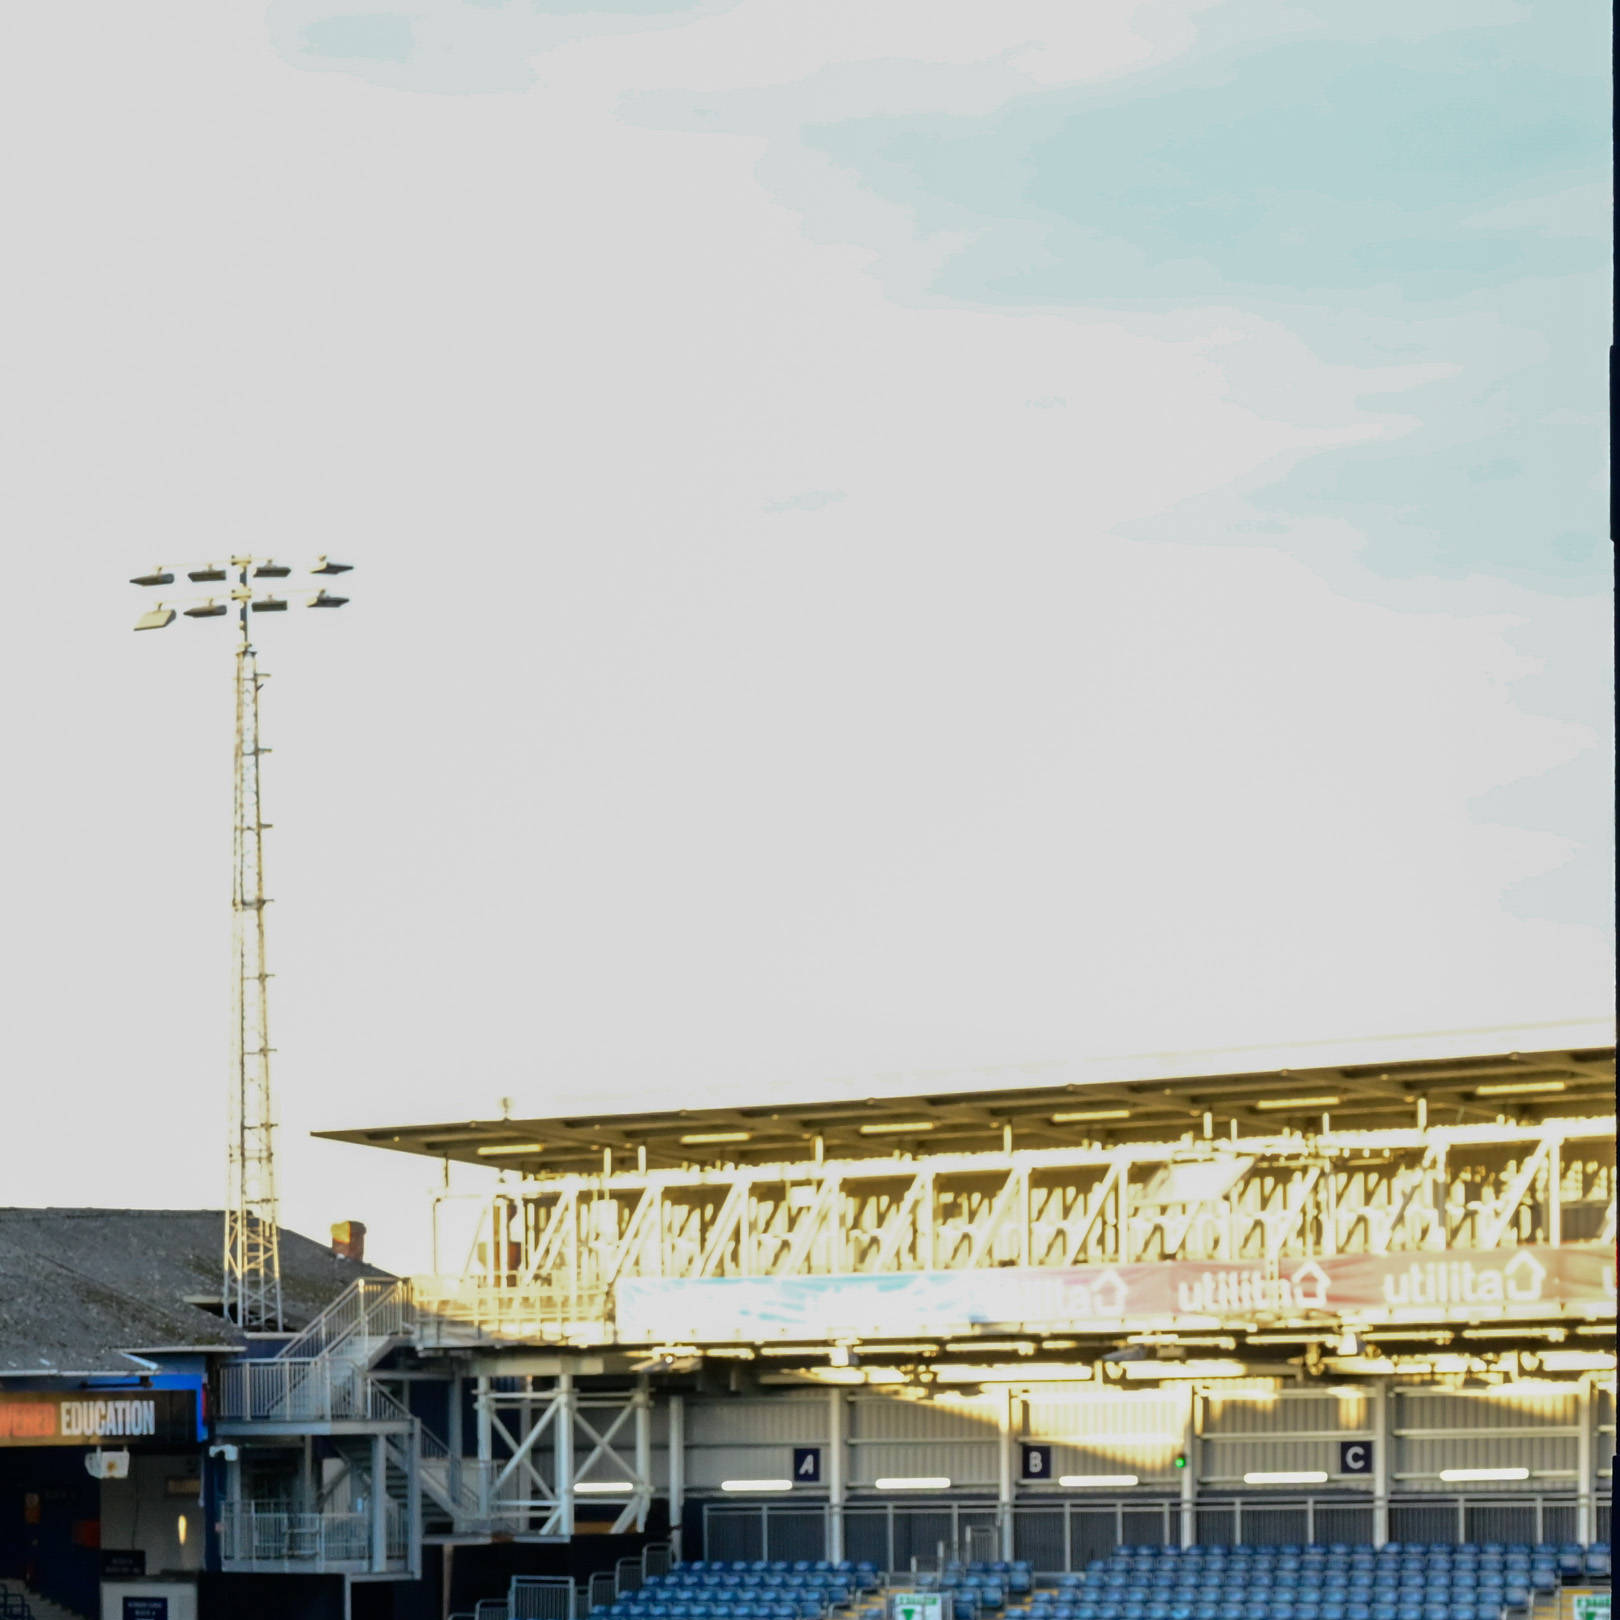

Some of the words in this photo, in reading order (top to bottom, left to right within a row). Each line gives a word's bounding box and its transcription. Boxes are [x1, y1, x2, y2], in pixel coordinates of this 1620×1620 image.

[1383, 1262, 1502, 1304] utilita
[61, 1400, 155, 1436] EDUCATION
[799, 1454, 814, 1475] A
[1029, 1451, 1042, 1473] B
[1346, 1446, 1365, 1470] C
